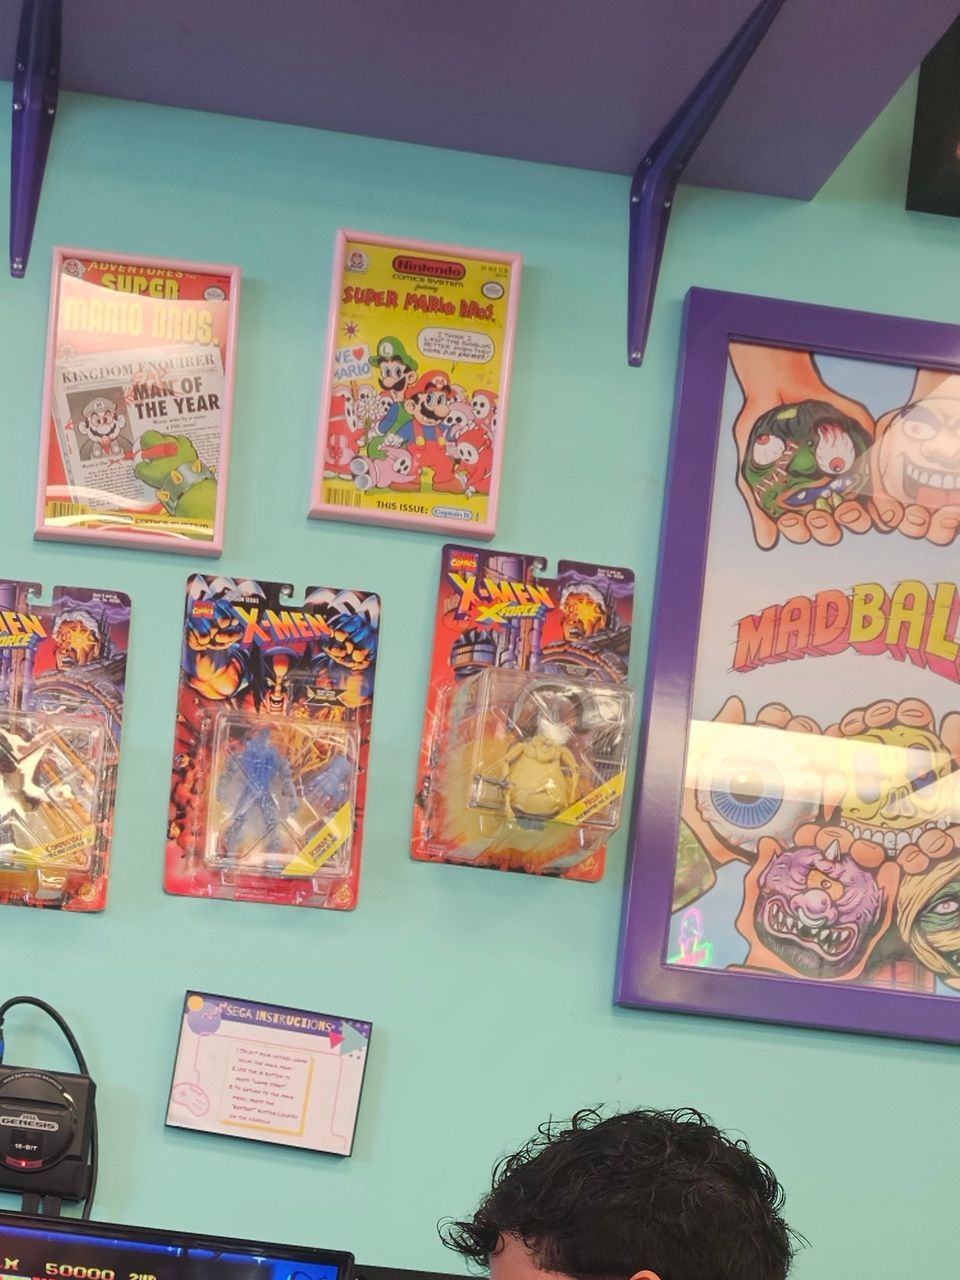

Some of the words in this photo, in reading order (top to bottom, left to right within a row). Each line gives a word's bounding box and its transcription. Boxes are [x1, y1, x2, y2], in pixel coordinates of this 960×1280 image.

[392, 273, 425, 283] COMICS
[426, 277, 465, 288] SYSTEM
[398, 258, 462, 278] Nintendo
[101, 273, 181, 300] SUPER
[342, 286, 399, 308] SUPER
[403, 292, 456, 315] MARIO
[62, 363, 135, 384] KINGDOM
[137, 353, 216, 376] ENQUIRER
[181, 376, 204, 394] OF
[135, 400, 169, 420] THE
[173, 392, 221, 415] YEAR
[376, 500, 397, 510] THIS
[399, 503, 428, 514] ISSUE:
[447, 571, 556, 614] X-MEN
[233, 606, 331, 644] X-MEN
[226, 1004, 253, 1020] SEGA
[255, 1010, 333, 1032] INSTRUCTIONS
[1, 1117, 56, 1130] GENESIS
[14, 1143, 38, 1151] 16-BIT
